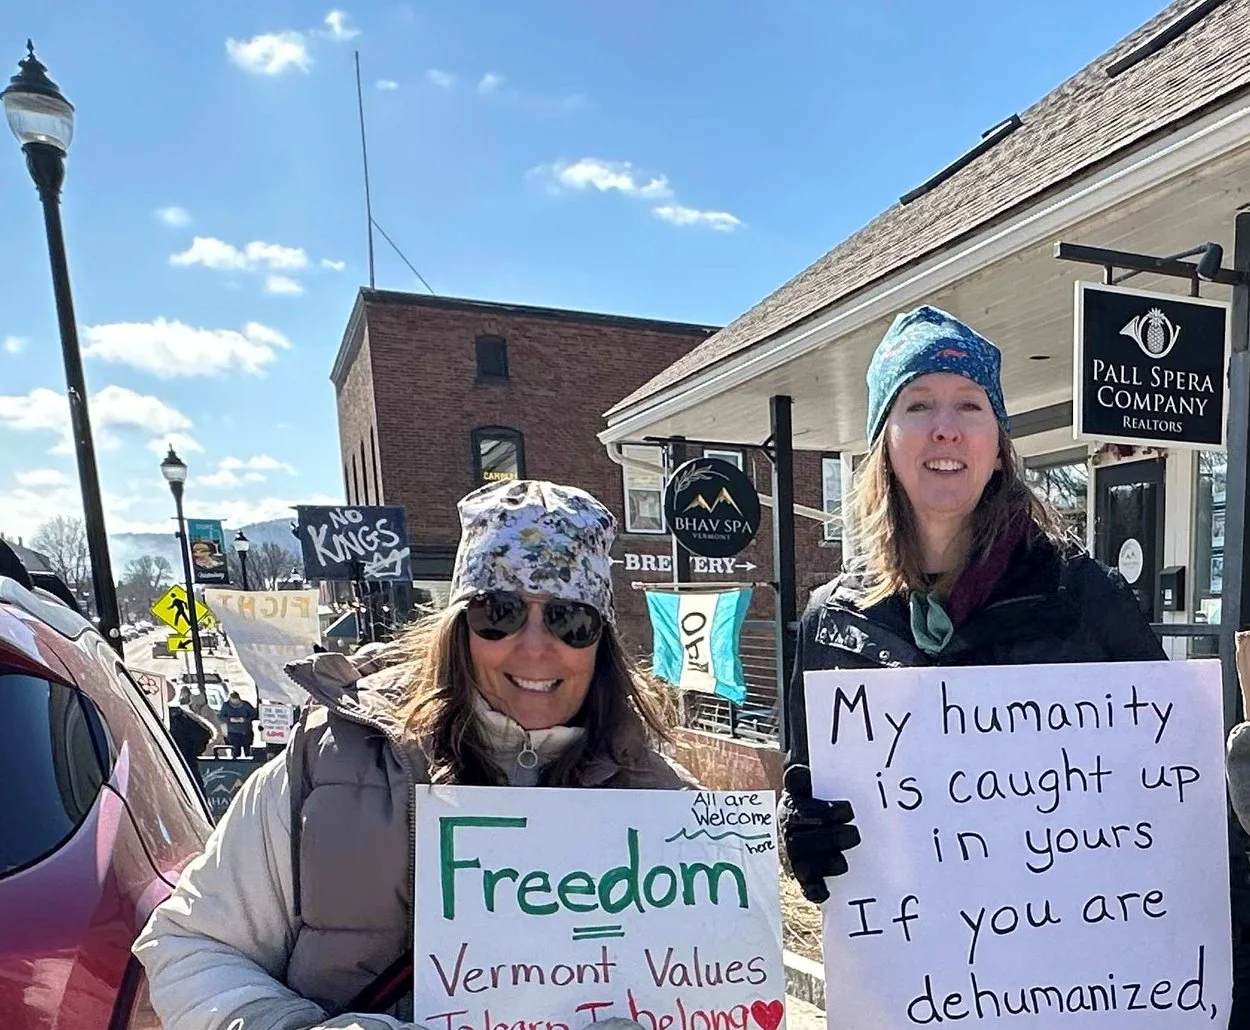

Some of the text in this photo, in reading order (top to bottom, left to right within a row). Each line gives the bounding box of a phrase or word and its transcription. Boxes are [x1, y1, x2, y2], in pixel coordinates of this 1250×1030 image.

[1092, 359, 1215, 393] PALL SPERA
[1097, 385, 1209, 417] COMPANY
[1122, 415, 1183, 433] REALTORS
[328, 507, 363, 529] NO
[674, 516, 753, 535] BHAV SPA
[307, 518, 400, 567] KINGS
[692, 532, 732, 541] VERMONT
[624, 553, 737, 574] BREERY
[831, 680, 1174, 768] My humanity
[876, 747, 1201, 814] is caught up
[693, 792, 762, 807] All are
[691, 807, 772, 827] Welcome
[745, 841, 775, 855] here
[933, 820, 1153, 874] in yours
[439, 816, 749, 920] Freedom
[847, 889, 1168, 965] If you are
[429, 943, 767, 997] Vermont Values
[907, 944, 1218, 1025] dehumanized,
